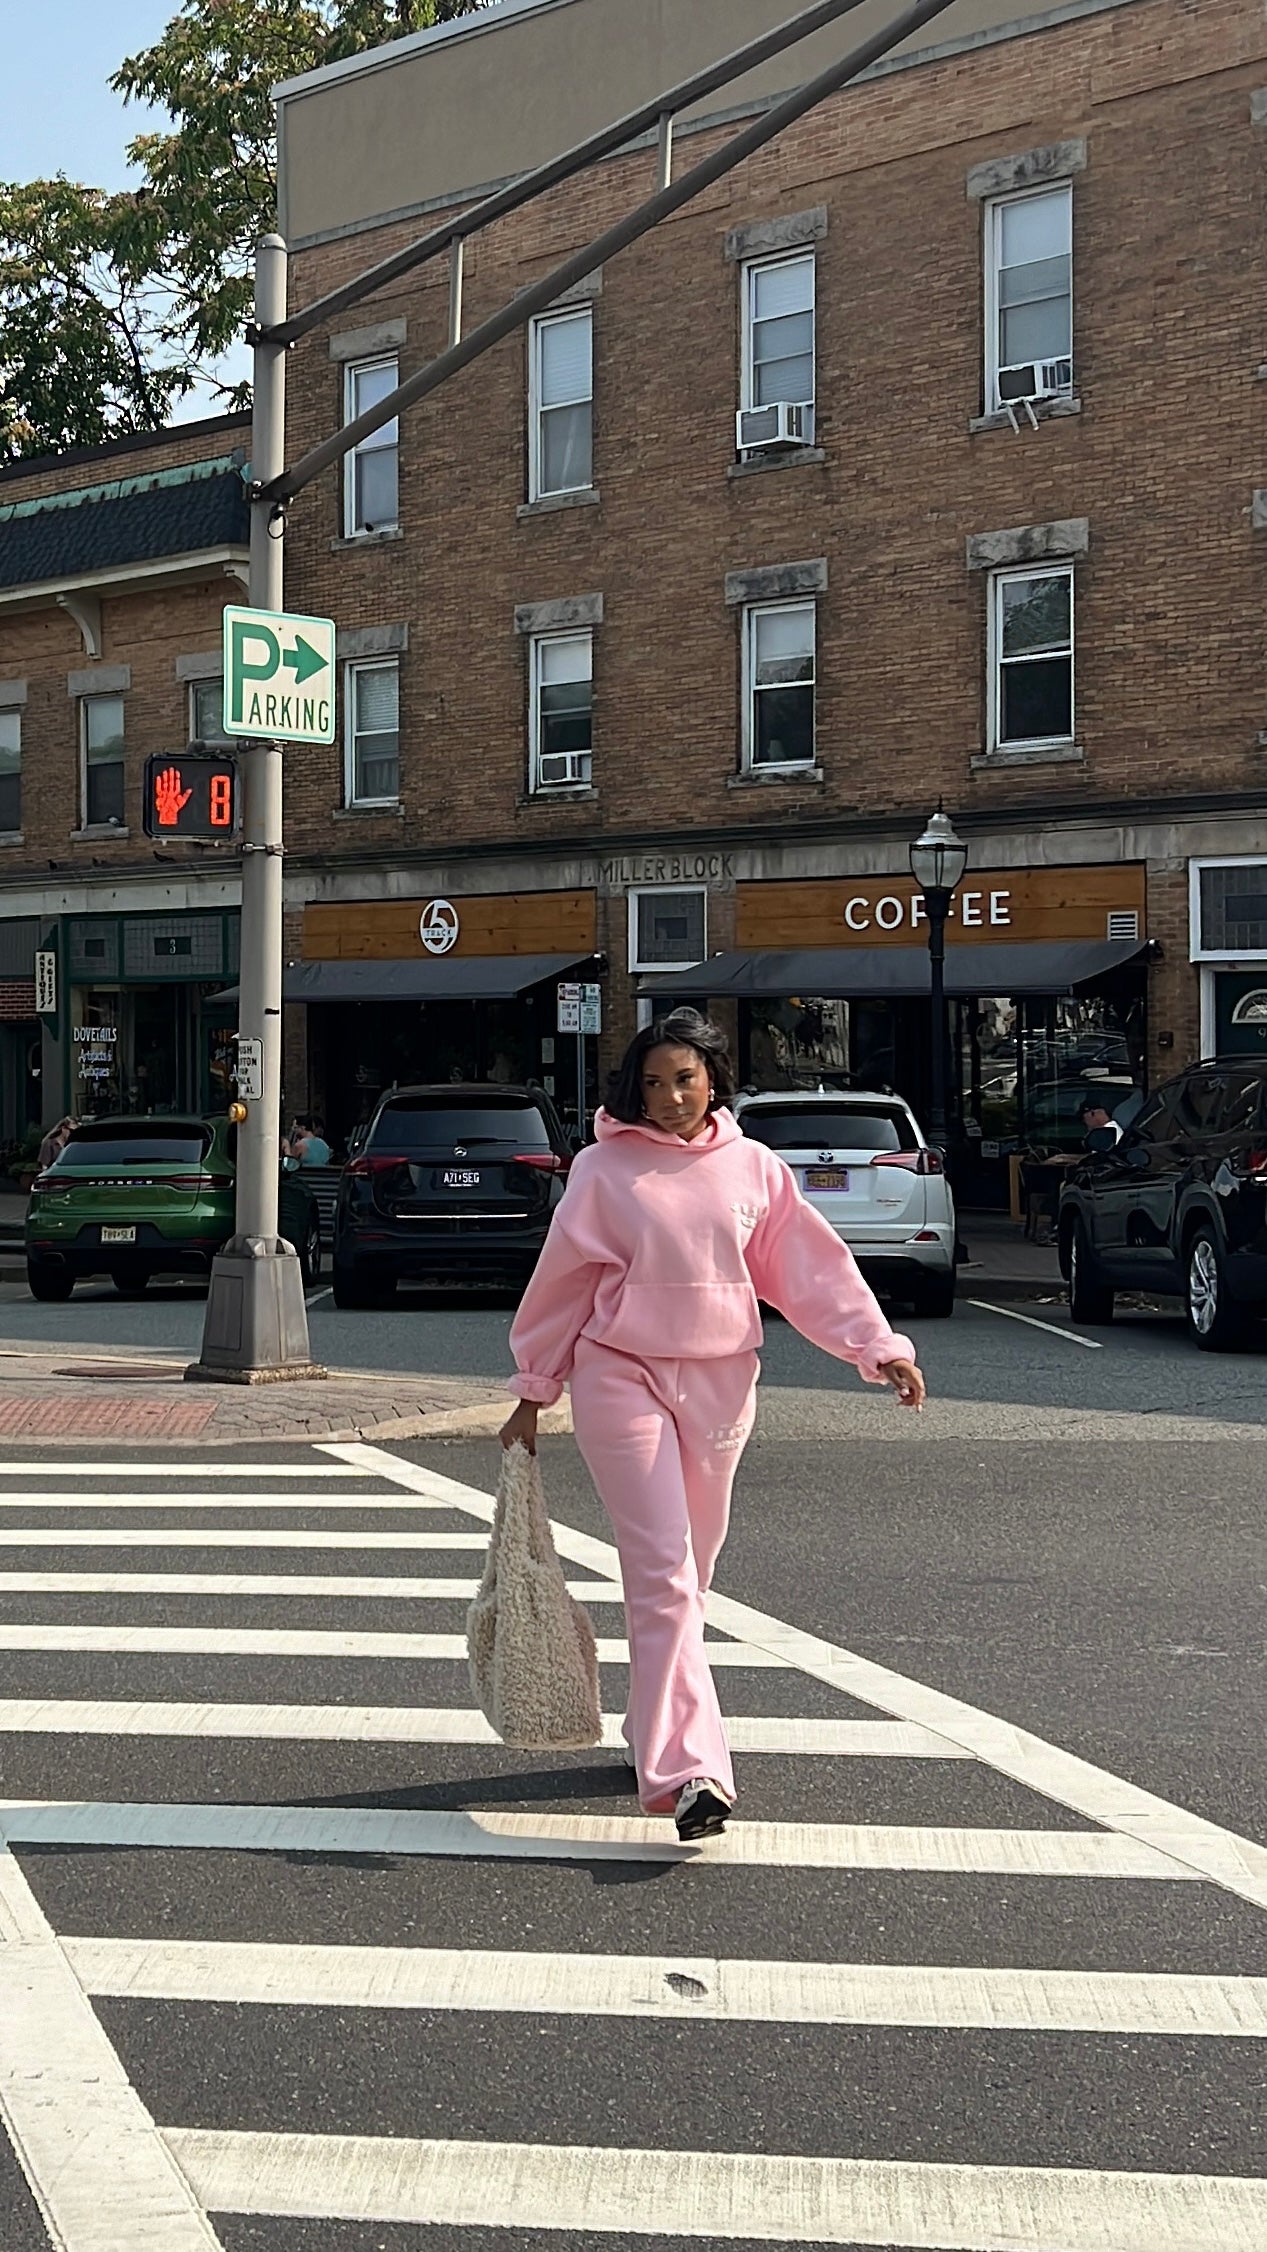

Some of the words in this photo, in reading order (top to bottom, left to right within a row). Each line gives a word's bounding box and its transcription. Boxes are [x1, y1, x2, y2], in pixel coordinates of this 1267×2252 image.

[231, 621, 329, 732] PARKING
[210, 775, 231, 825] 8
[599, 858, 665, 882] MILLER
[671, 854, 733, 879] BLOCK
[844, 890, 1011, 930] COFEE
[169, 938, 176, 954] 3
[426, 929, 451, 937] TRACK
[73, 1026, 117, 1042] DOVETAILS
